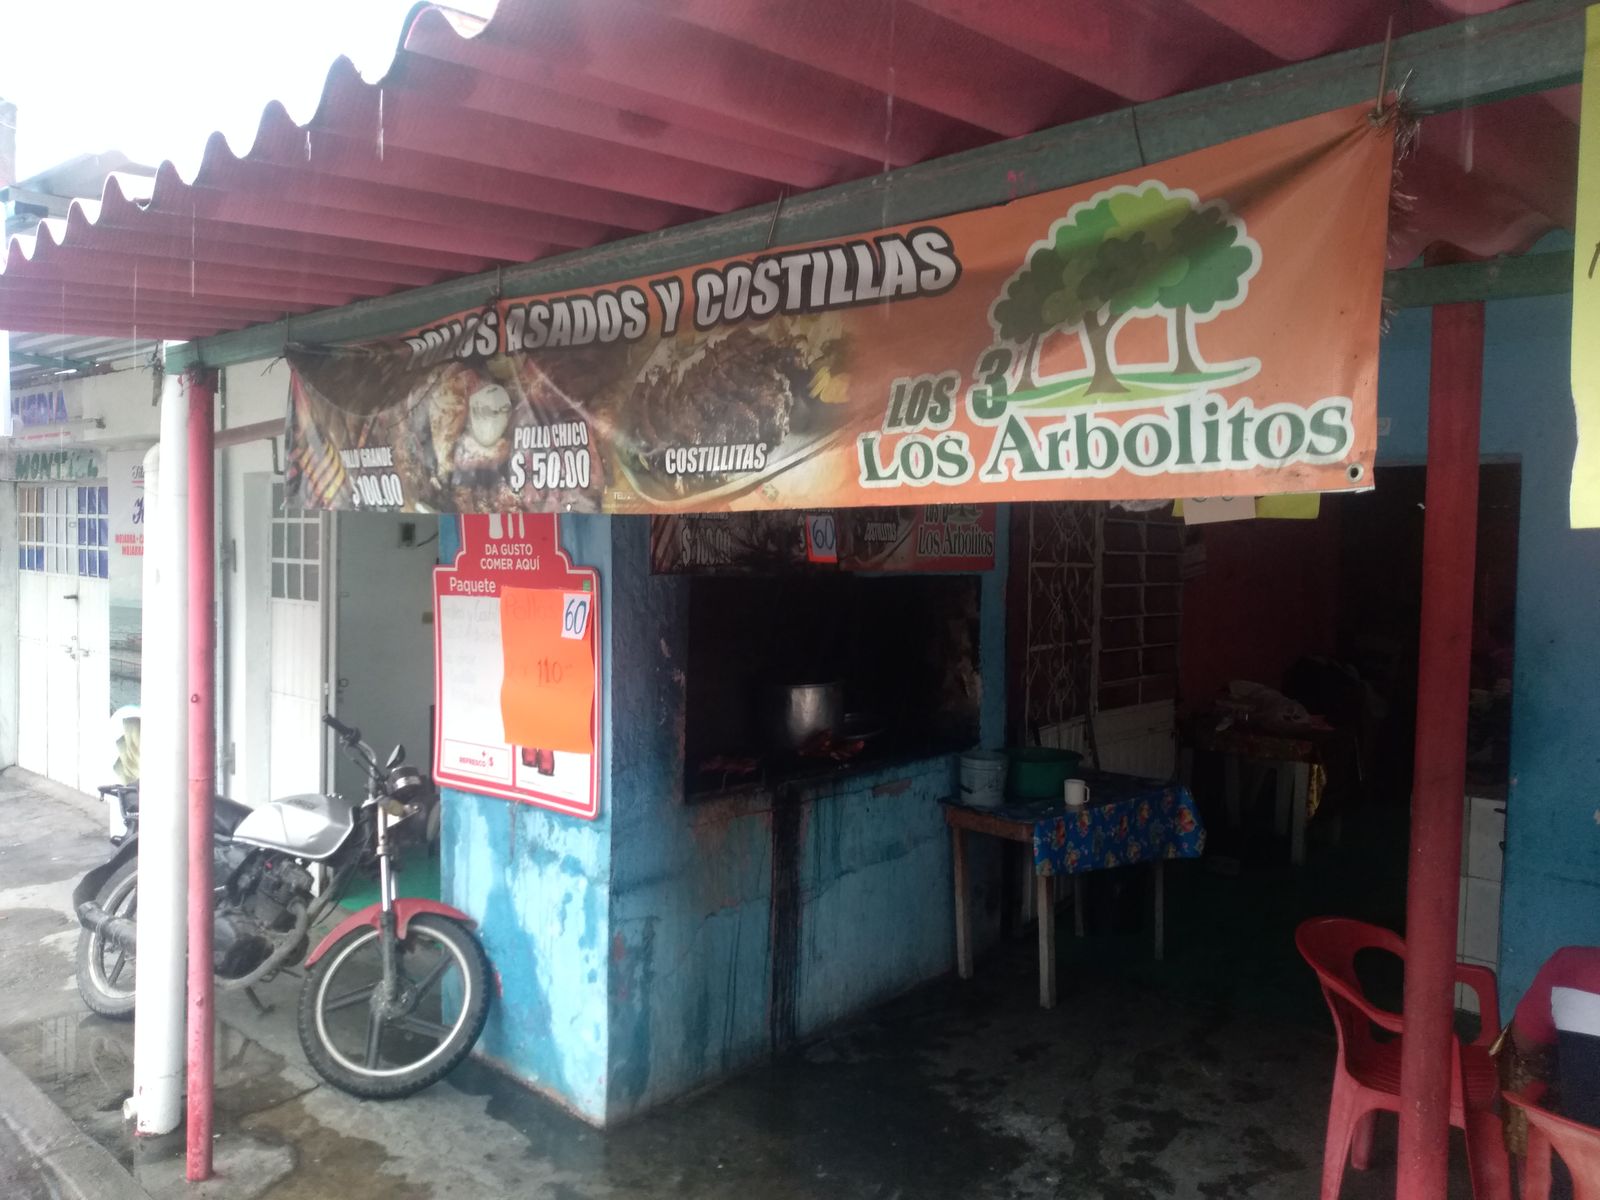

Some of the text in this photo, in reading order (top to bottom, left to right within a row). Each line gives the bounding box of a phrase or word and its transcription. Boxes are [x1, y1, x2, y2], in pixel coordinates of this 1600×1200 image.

[505, 288, 648, 352] ASADOS
[657, 281, 682, 333] Y
[696, 232, 958, 326] COSTILLAS
[887, 346, 1013, 428] LOS 3
[513, 421, 588, 449] POLLO CHICO
[985, 401, 1349, 476] Arbolitos
[665, 443, 767, 474] COSTILLITAS
[812, 518, 835, 549] 60
[943, 524, 993, 556] Arbolitos
[480, 556, 540, 570] COMER AQUÍ
[485, 544, 533, 556] DA GUSTO
[449, 577, 496, 594] Paquete
[564, 599, 587, 635] 60
